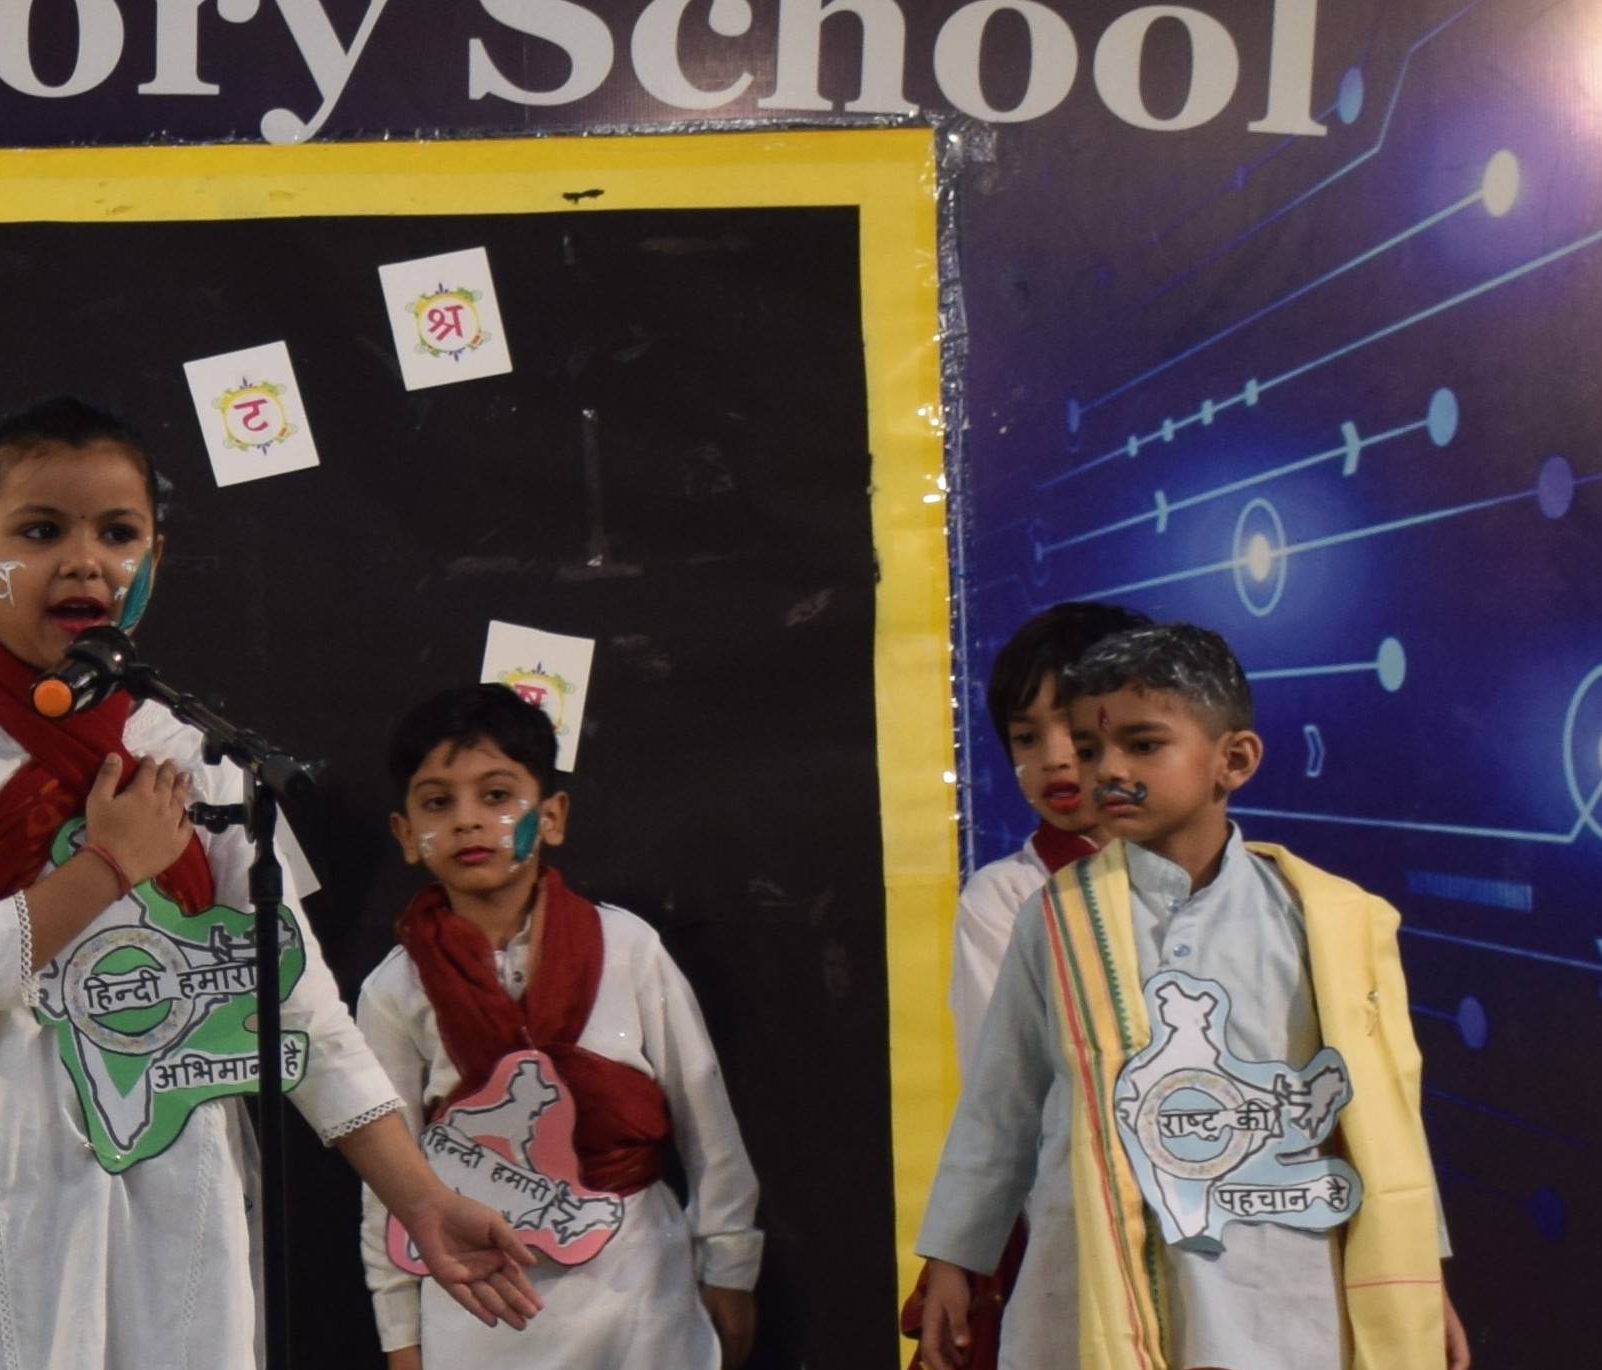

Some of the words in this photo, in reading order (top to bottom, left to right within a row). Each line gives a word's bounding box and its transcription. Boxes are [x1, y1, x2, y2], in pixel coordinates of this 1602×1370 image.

[468, 0, 1327, 136] School
[233, 398, 271, 434] ट
[83, 968, 161, 1009] हिन्दी
[283, 1040, 302, 1077] है
[1235, 1101, 1270, 1131] की
[426, 1126, 484, 1169] हिन्दी
[491, 1161, 551, 1202] हमारी
[1218, 1187, 1310, 1213] पहचान
[1326, 1176, 1346, 1212] है
